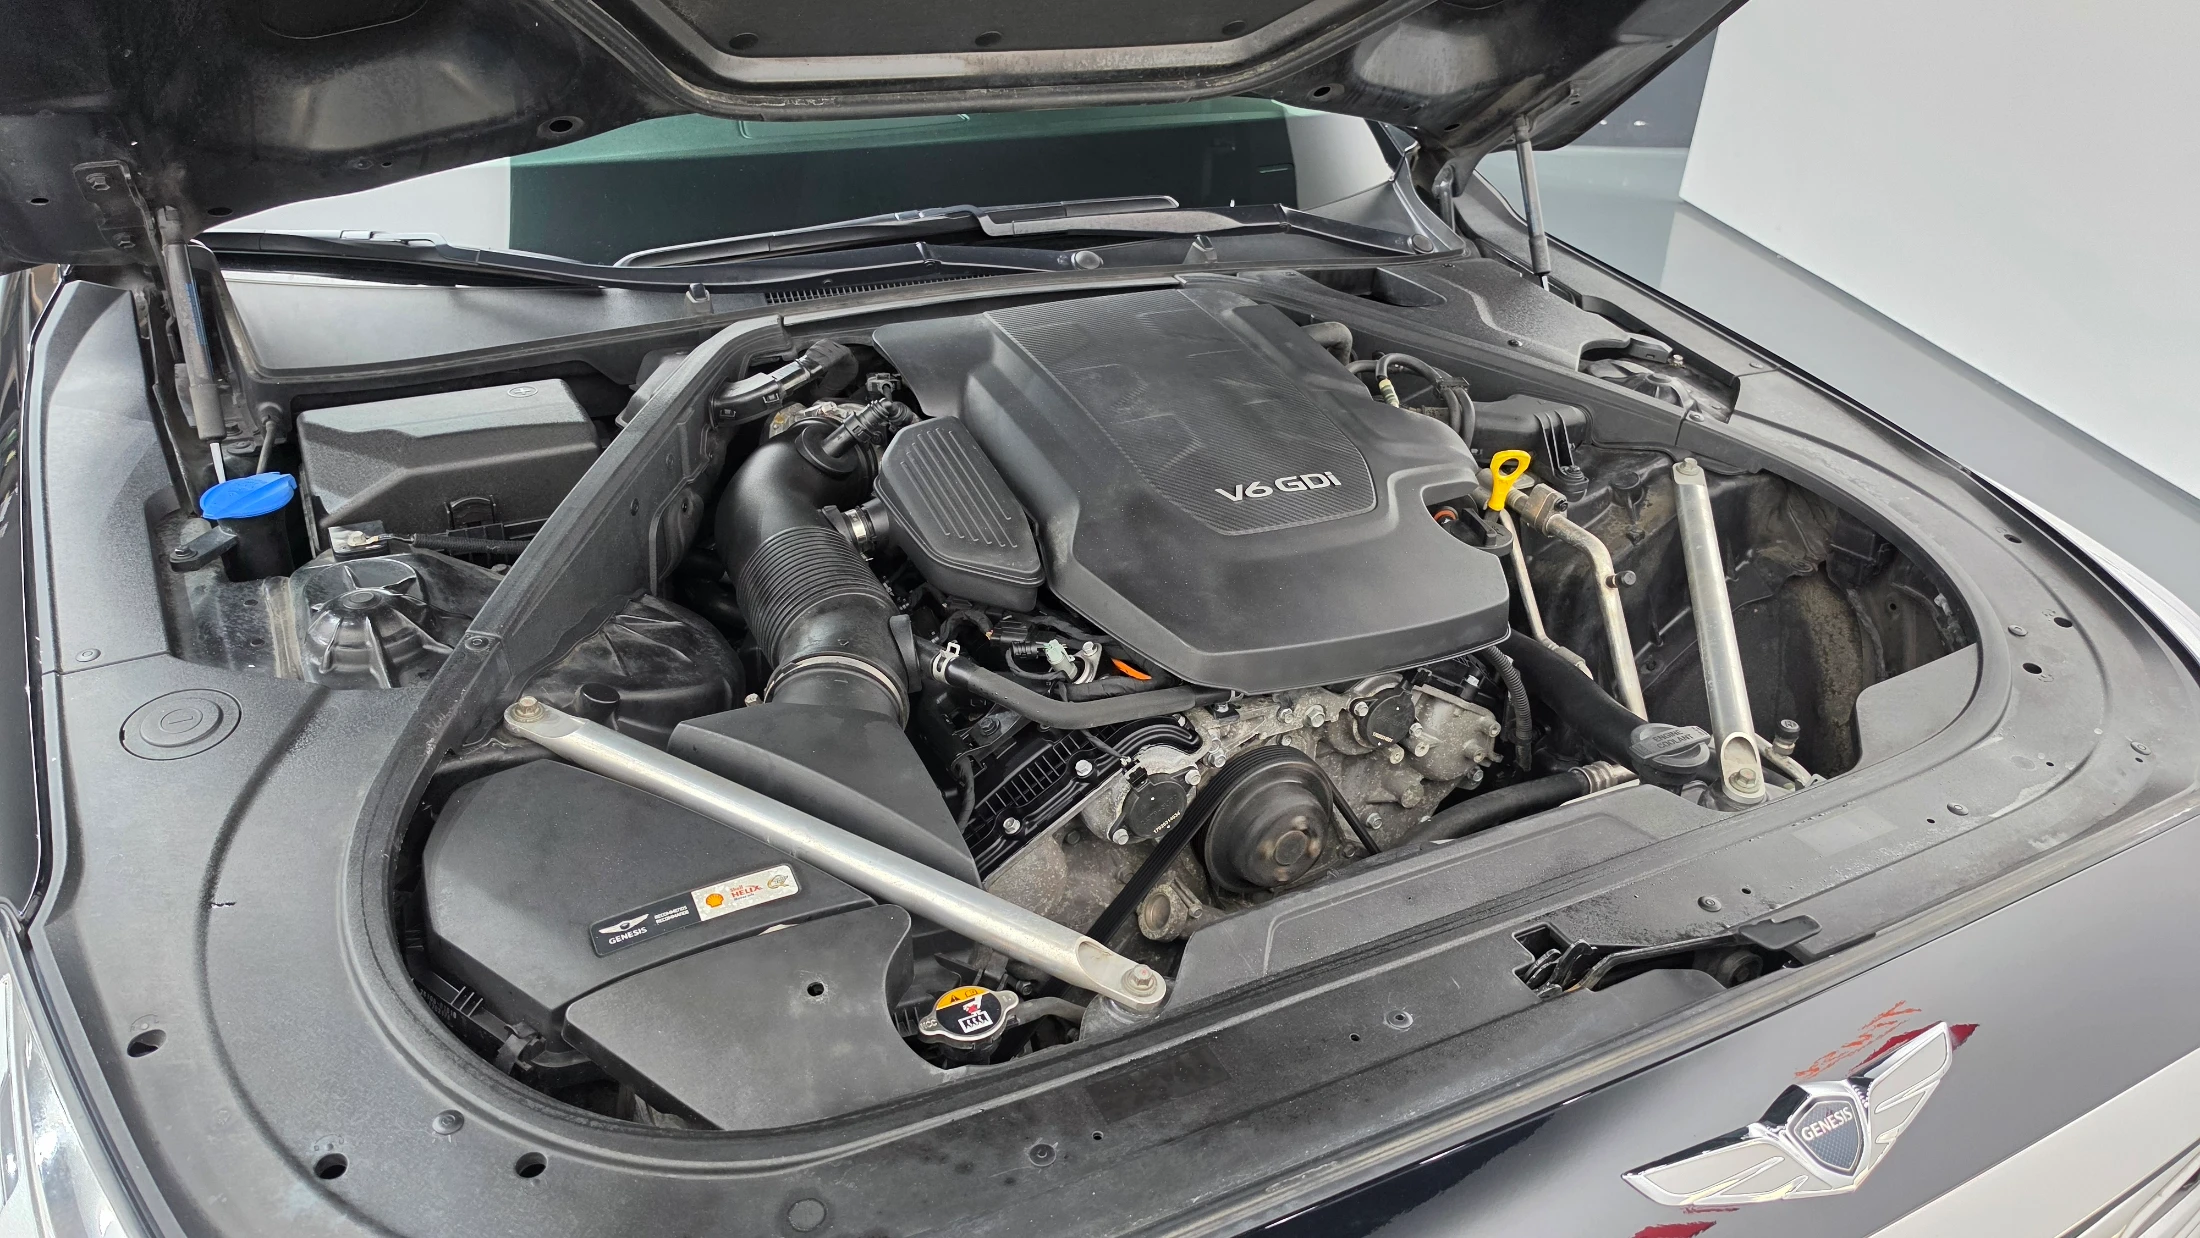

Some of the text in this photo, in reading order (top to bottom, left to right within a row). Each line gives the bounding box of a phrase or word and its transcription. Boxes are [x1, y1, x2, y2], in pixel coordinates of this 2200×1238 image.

[1214, 471, 1342, 501] V6 GDi
[1652, 729, 1684, 743] ENGINE
[1656, 733, 1694, 749] COOLANT
[729, 884, 744, 893] Shell
[731, 884, 763, 898] HELIX
[608, 926, 648, 945] GENESIS
[1801, 1106, 1853, 1141] GENESIS
